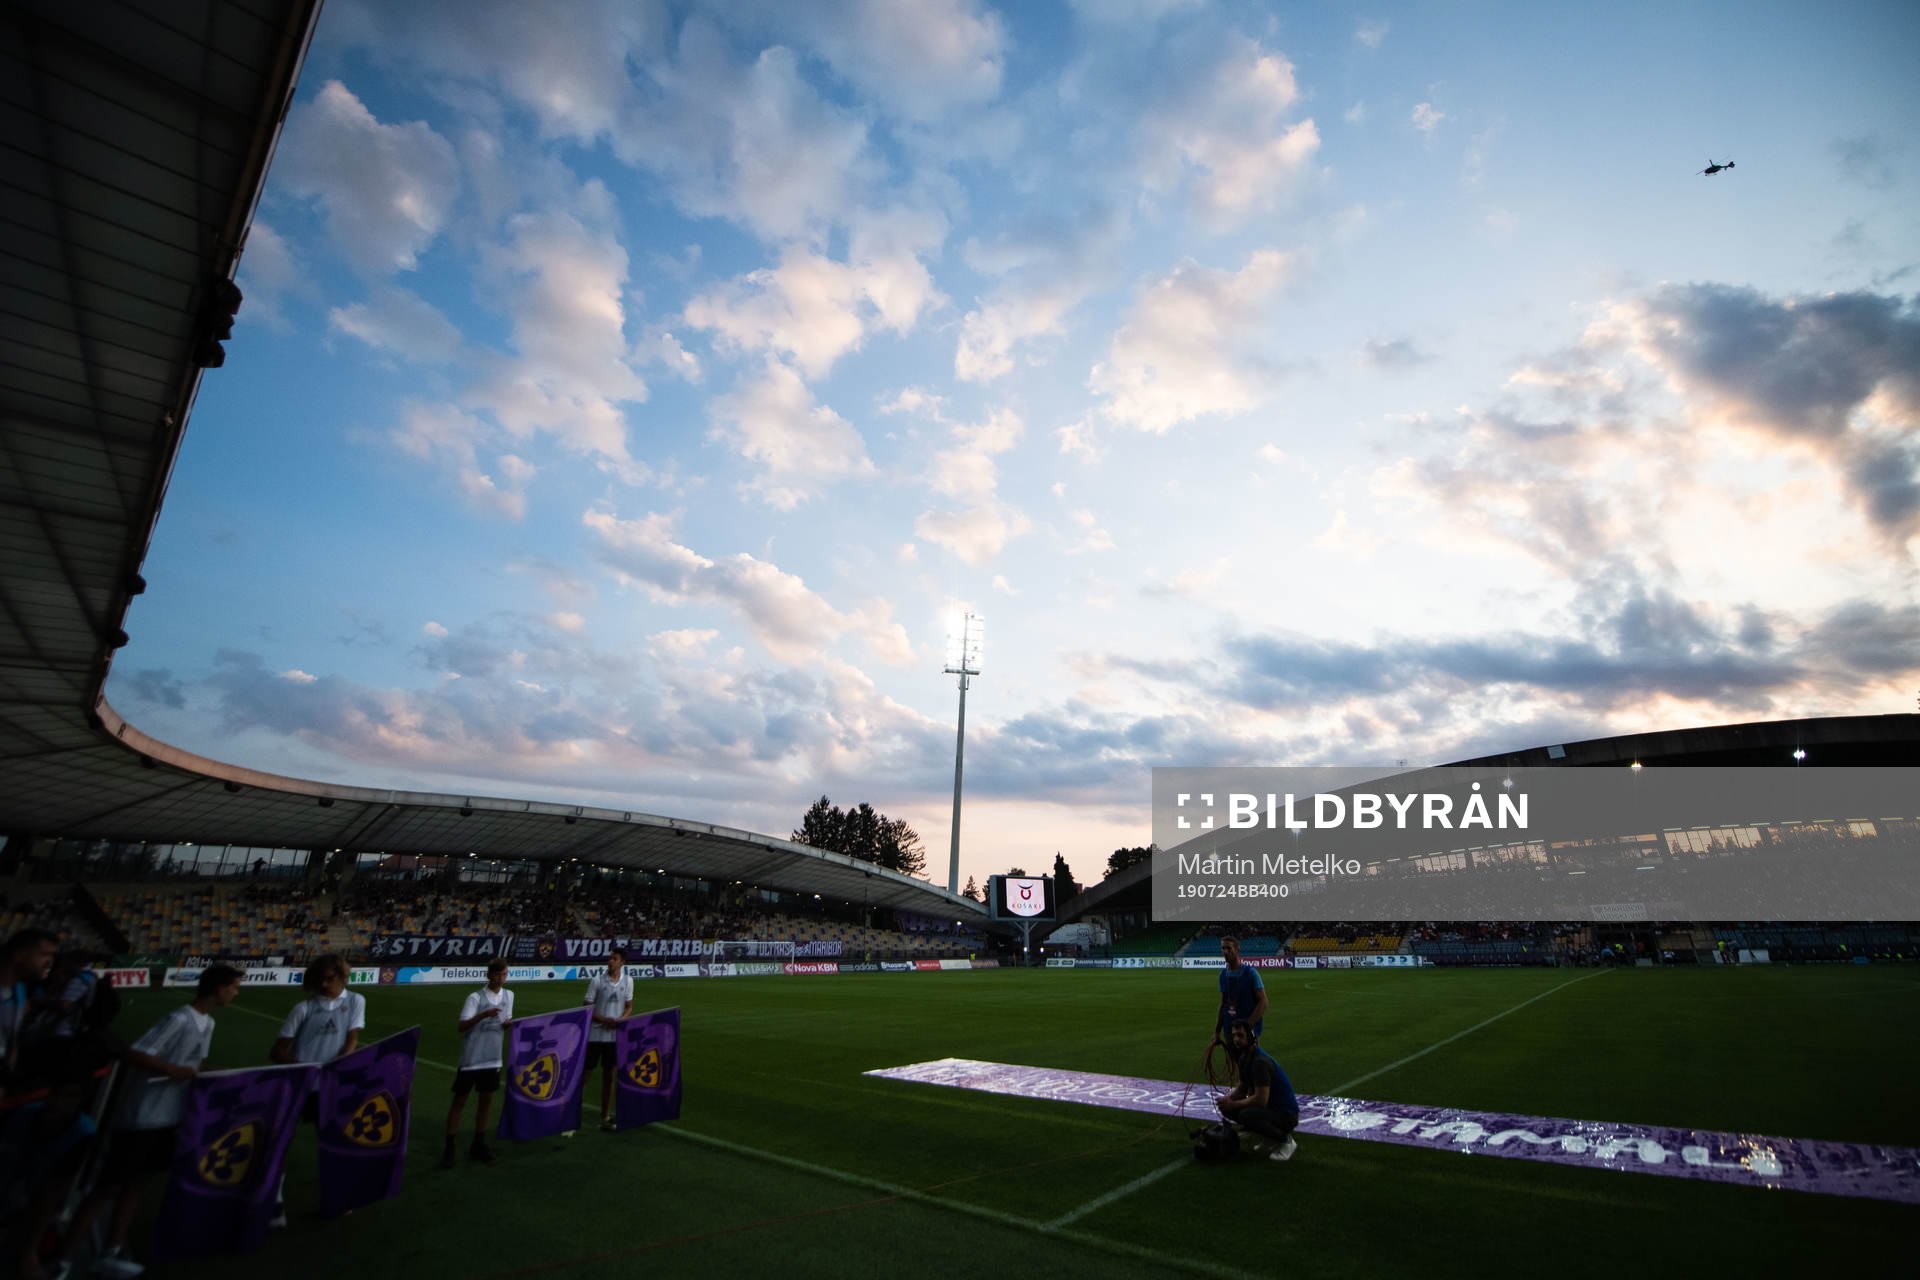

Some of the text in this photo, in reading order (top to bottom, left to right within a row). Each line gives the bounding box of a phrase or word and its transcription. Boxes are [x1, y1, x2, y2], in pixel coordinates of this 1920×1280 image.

[391, 937, 494, 957] STYRIA
[641, 939, 724, 956] MARIBOR
[793, 963, 838, 973] Nova KBM
[1260, 958, 1284, 967] KBM
